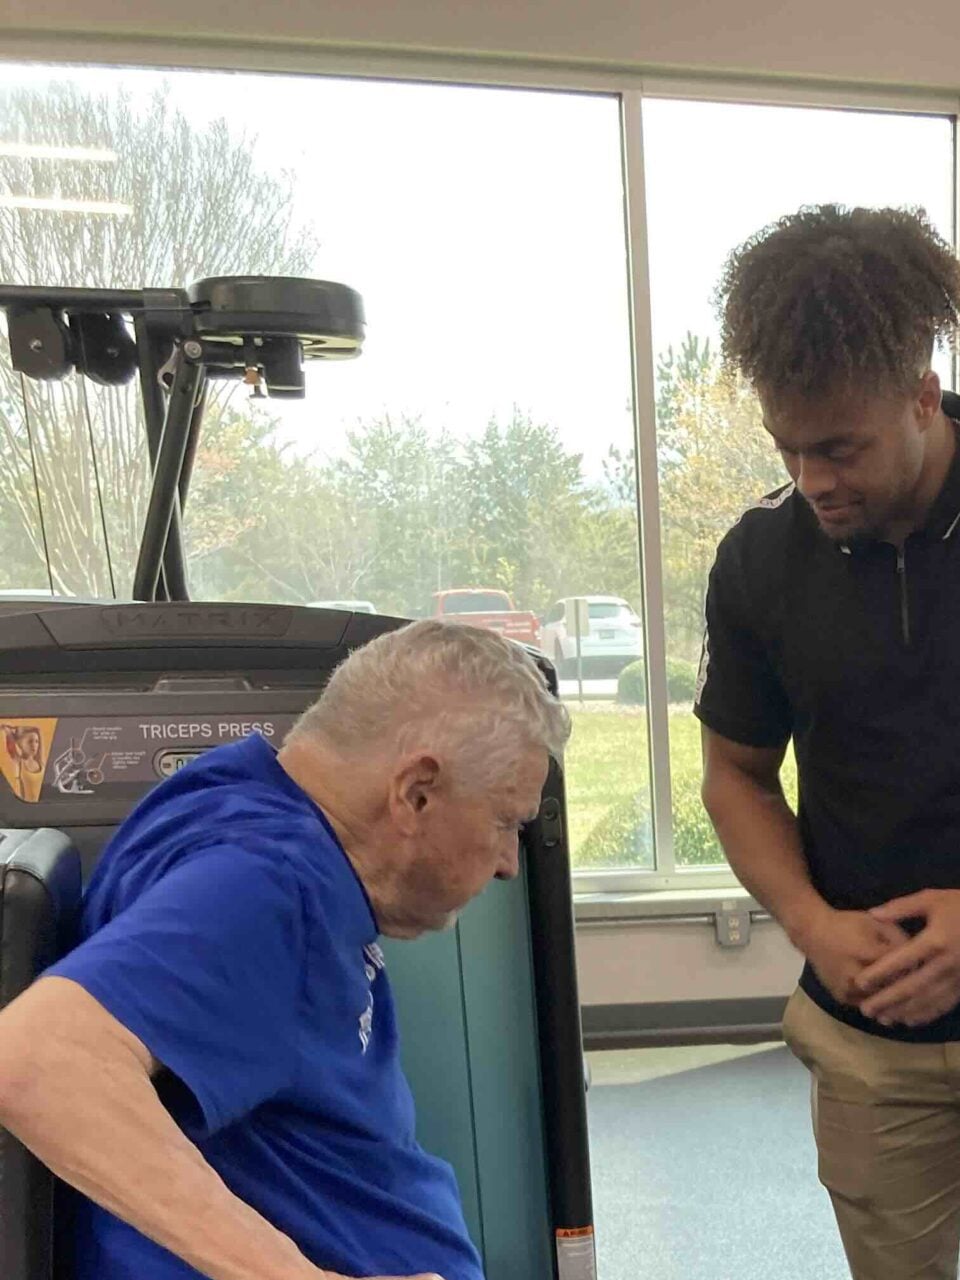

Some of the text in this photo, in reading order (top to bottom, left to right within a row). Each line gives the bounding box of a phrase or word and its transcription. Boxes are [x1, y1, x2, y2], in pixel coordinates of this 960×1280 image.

[117, 610, 278, 630] MATRIX
[138, 722, 212, 740] TRICEPS
[218, 721, 276, 738] PRESS
